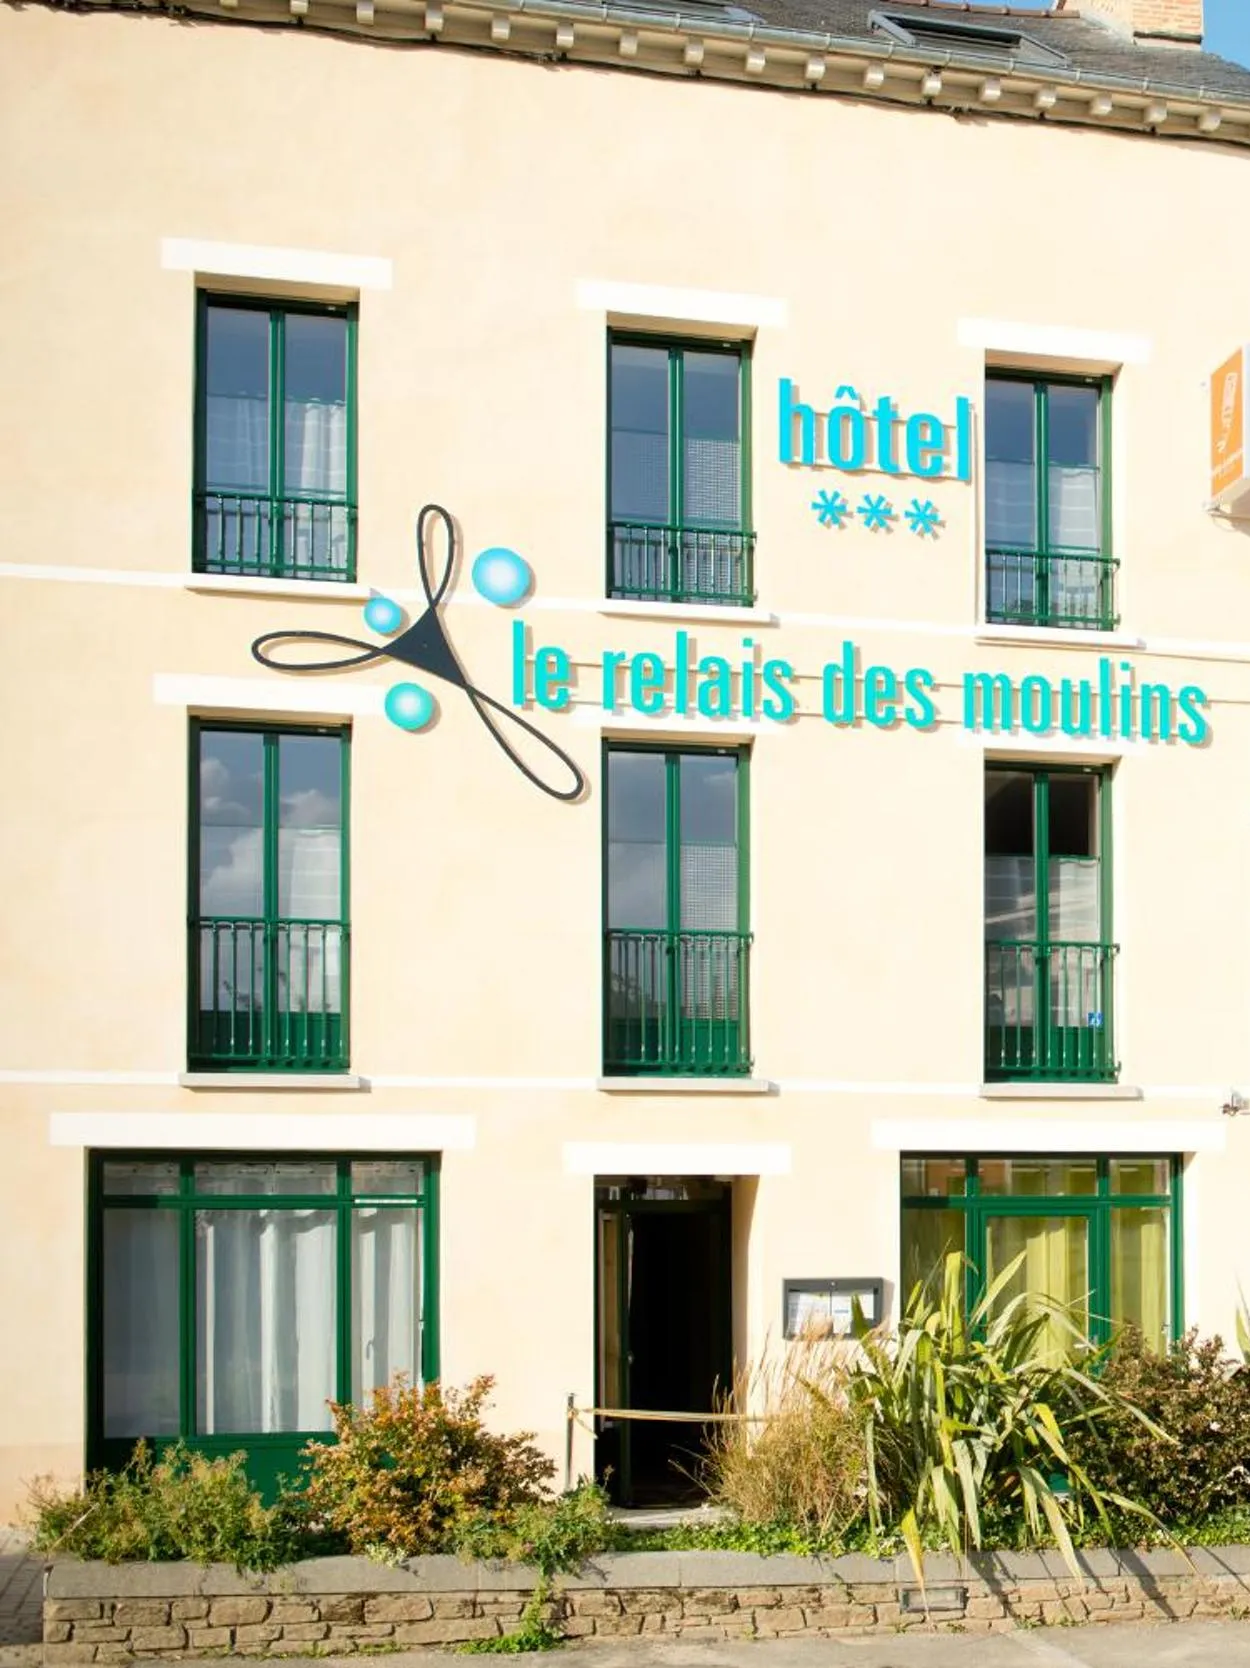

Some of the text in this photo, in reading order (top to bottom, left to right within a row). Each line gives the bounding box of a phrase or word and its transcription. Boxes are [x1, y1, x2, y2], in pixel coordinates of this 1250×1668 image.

[779, 377, 971, 482] hôtel
[512, 620, 1209, 745] le relais des moulins
